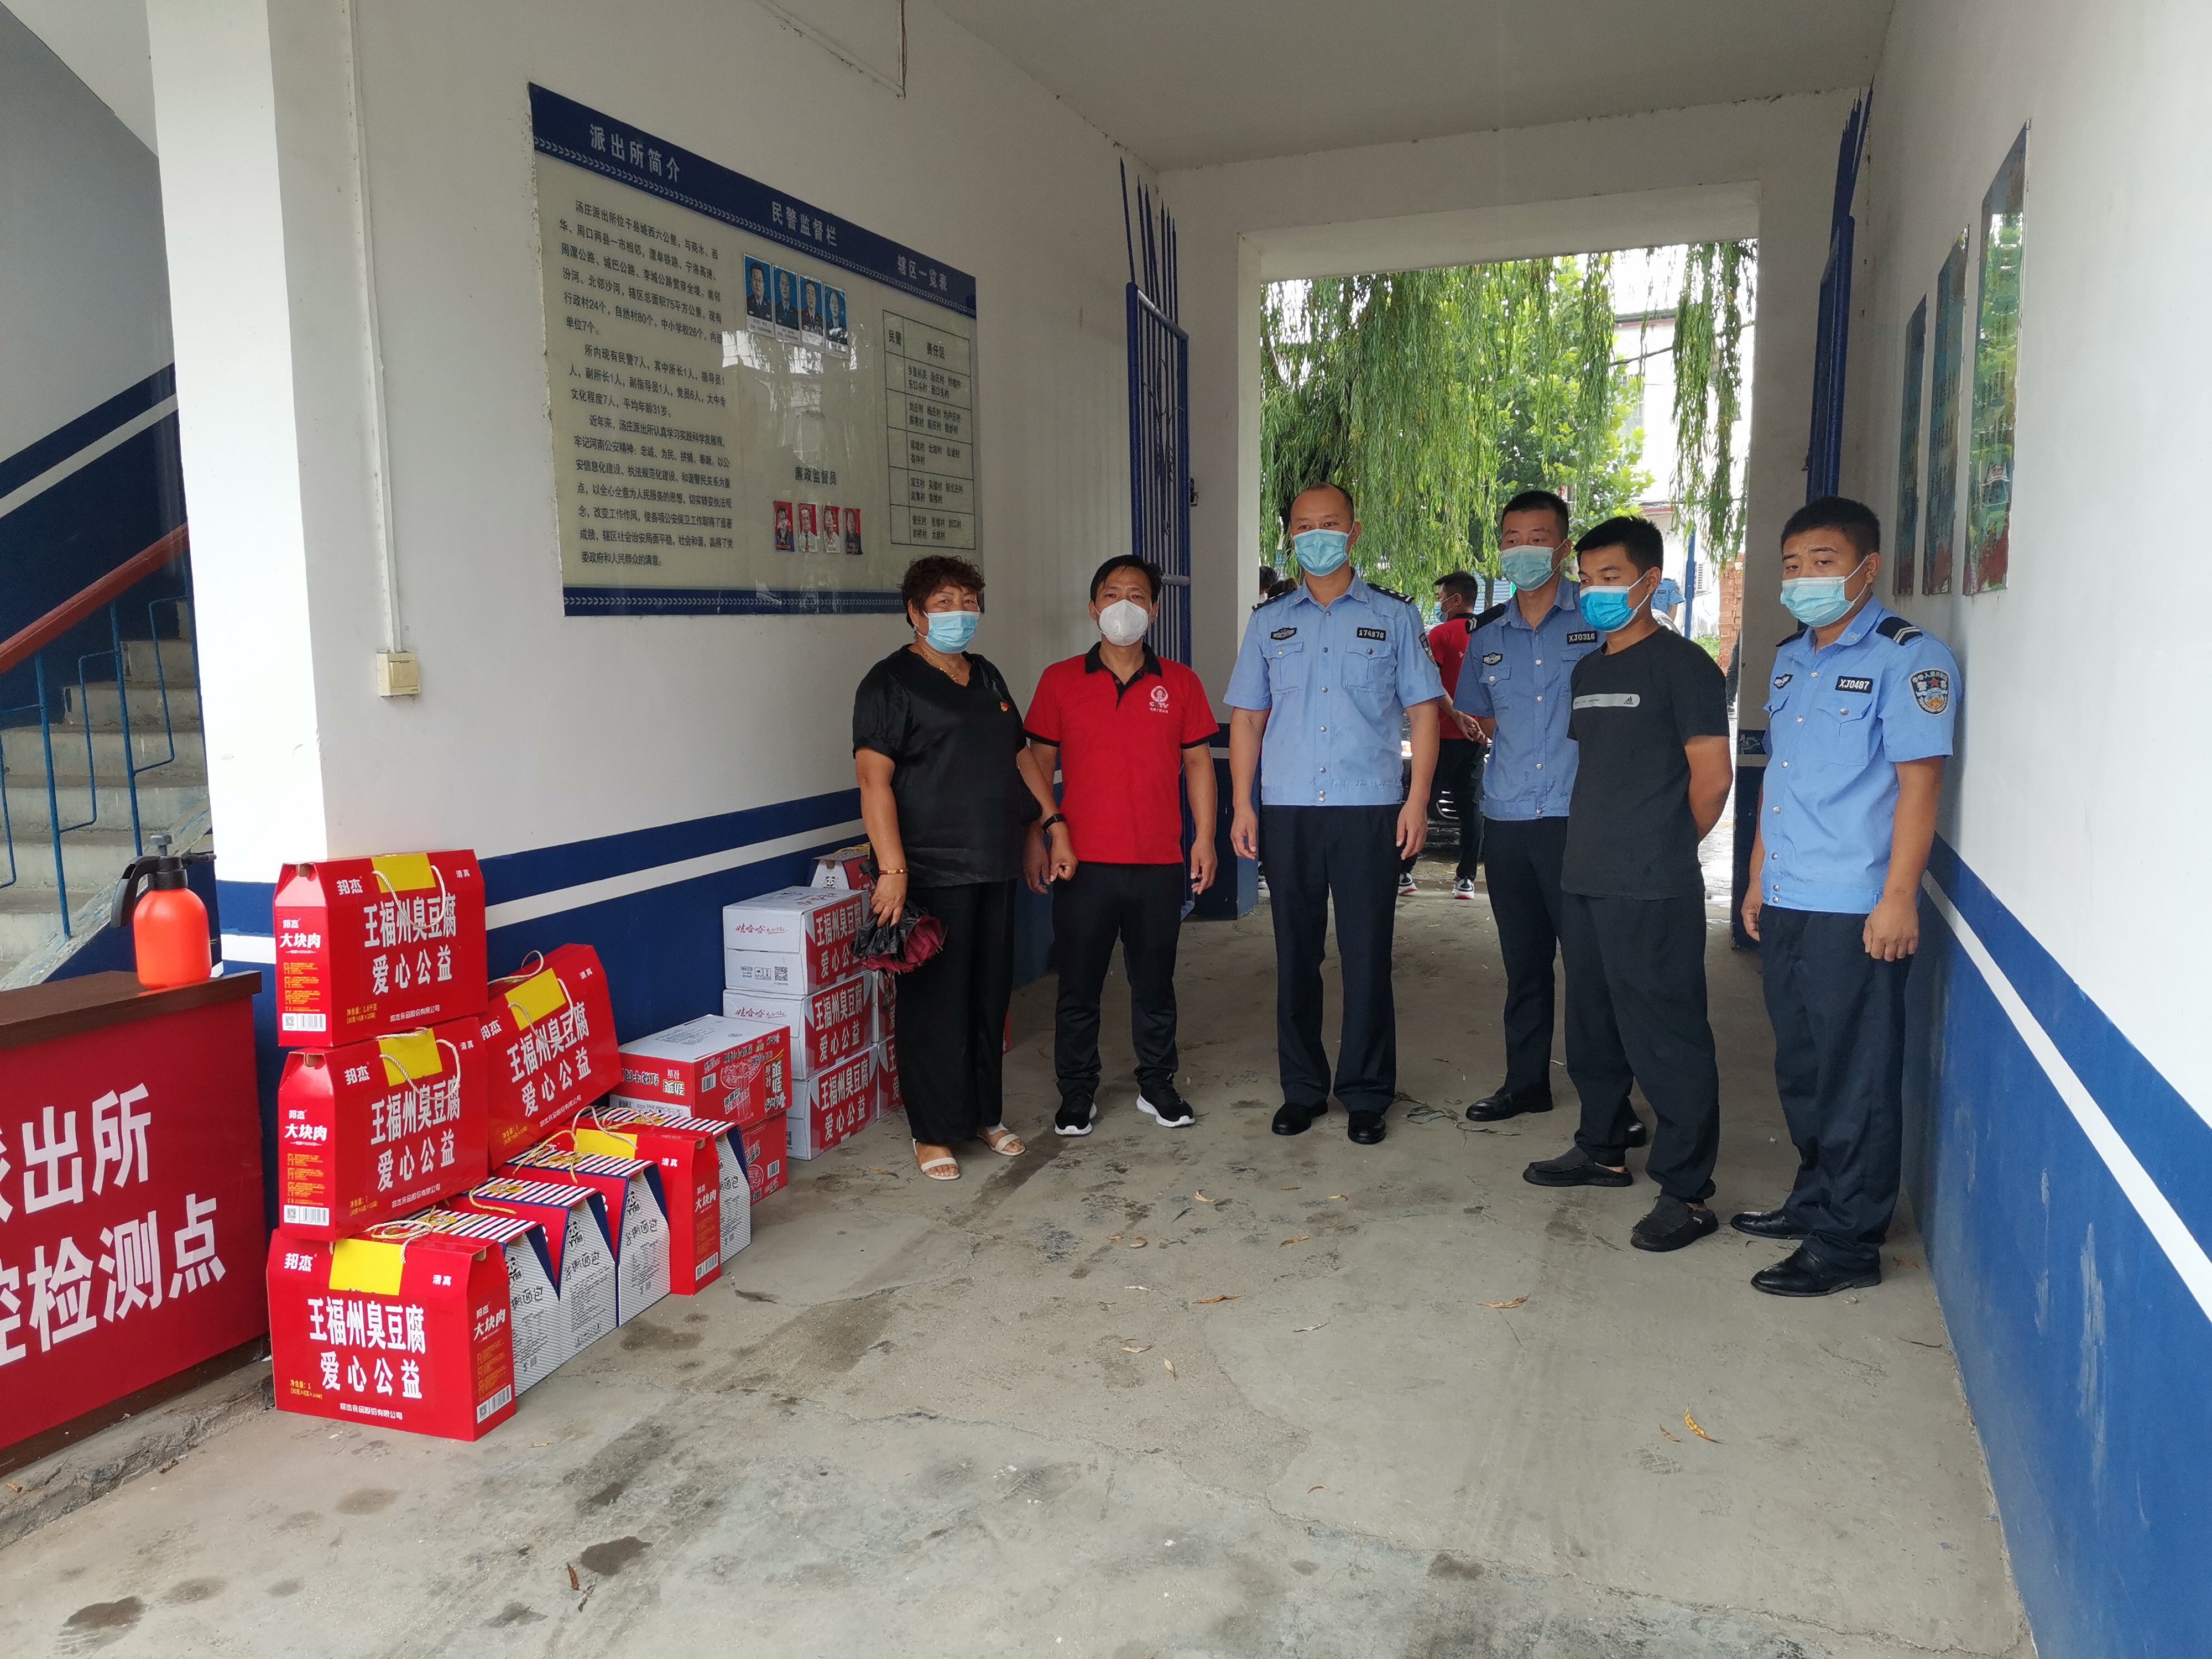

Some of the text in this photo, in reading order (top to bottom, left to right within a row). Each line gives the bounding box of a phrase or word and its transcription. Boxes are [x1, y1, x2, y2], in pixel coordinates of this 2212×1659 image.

[589, 123, 681, 183] 派出所简介
[771, 201, 838, 247] 民警监督栏
[897, 254, 948, 293] 辖区一览表
[566, 315, 599, 336] 单位7个。
[888, 328, 902, 346] 民警
[926, 341, 946, 359] 责任区
[795, 466, 837, 486] 廉政监督员
[1839, 679, 1870, 690] XJ0487
[336, 878, 364, 895] 邦杰
[456, 869, 471, 878] 清真
[363, 893, 457, 948] 王福州臭豆腐
[816, 901, 863, 947] 王福州臭豆腐
[279, 932, 321, 949] 大块肉
[372, 944, 453, 995] 爱心公益
[821, 942, 860, 979] 爱心公
[815, 982, 863, 1031] 王福州臭豆腐
[506, 1001, 590, 1084] 王福州臭豆腐
[819, 1020, 860, 1063] 爱心公益
[344, 1065, 371, 1086] 邦杰
[521, 1046, 592, 1117] 爱心公益
[622, 1068, 659, 1087] 红烧牛肉
[821, 1057, 868, 1112] 王福州臭豆腐
[371, 1074, 461, 1145] 王福州臭豆腐
[825, 1094, 866, 1142] 爱心公益
[284, 1123, 328, 1142] 大块肉
[0, 1082, 152, 1223] 出所
[378, 1128, 456, 1192] 爱心公益
[661, 1157, 679, 1168] 清真
[695, 1189, 717, 1213] 大块肉
[284, 1252, 314, 1272] 邦杰
[432, 1274, 452, 1286] 清真
[307, 1296, 427, 1355] 王福州臭豆腐
[473, 1308, 507, 1342] 大块肉
[320, 1351, 423, 1400] 爱心公益
[339, 1402, 403, 1421] 邦杰食品股份有限公司
